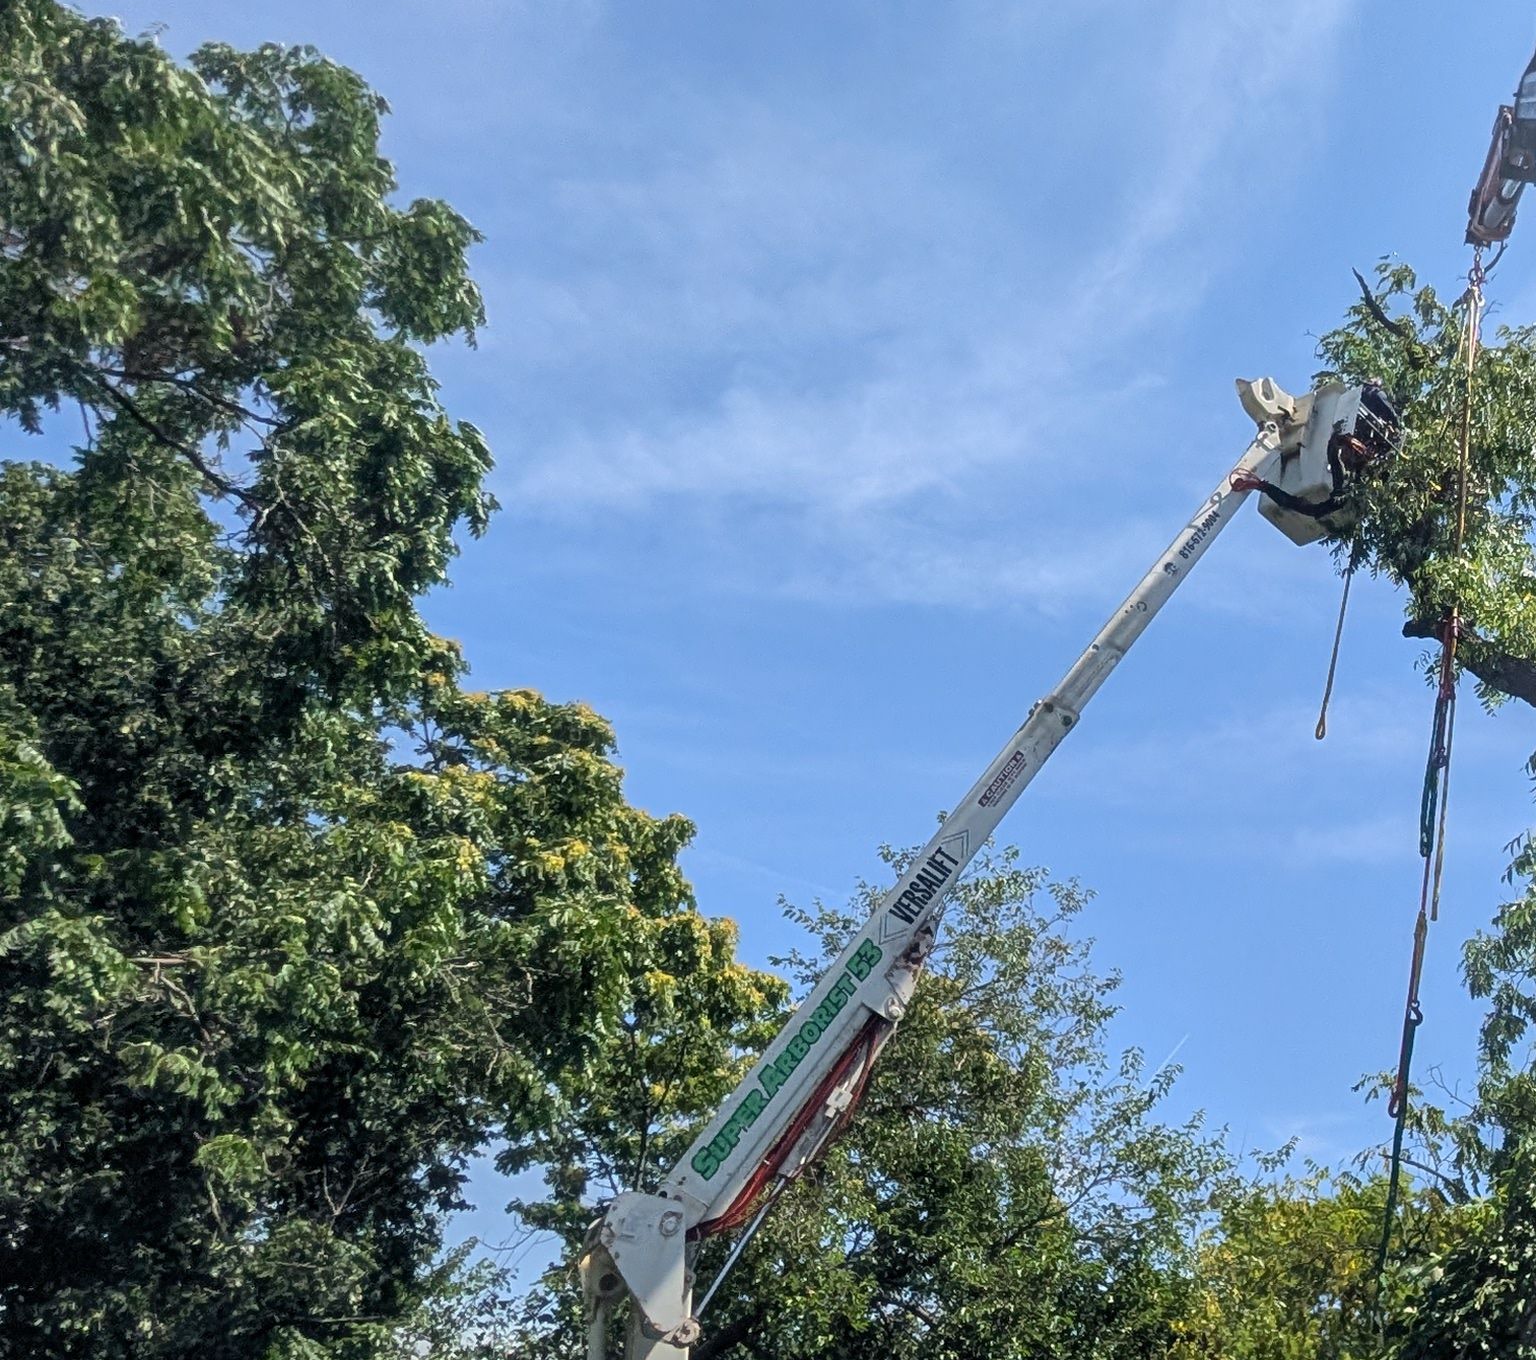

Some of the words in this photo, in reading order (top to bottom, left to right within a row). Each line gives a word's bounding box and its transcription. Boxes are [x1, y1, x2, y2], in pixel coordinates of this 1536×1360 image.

[986, 759, 1018, 798] CAUTION
[888, 846, 959, 925] VERSALIFT
[846, 938, 883, 982] 53
